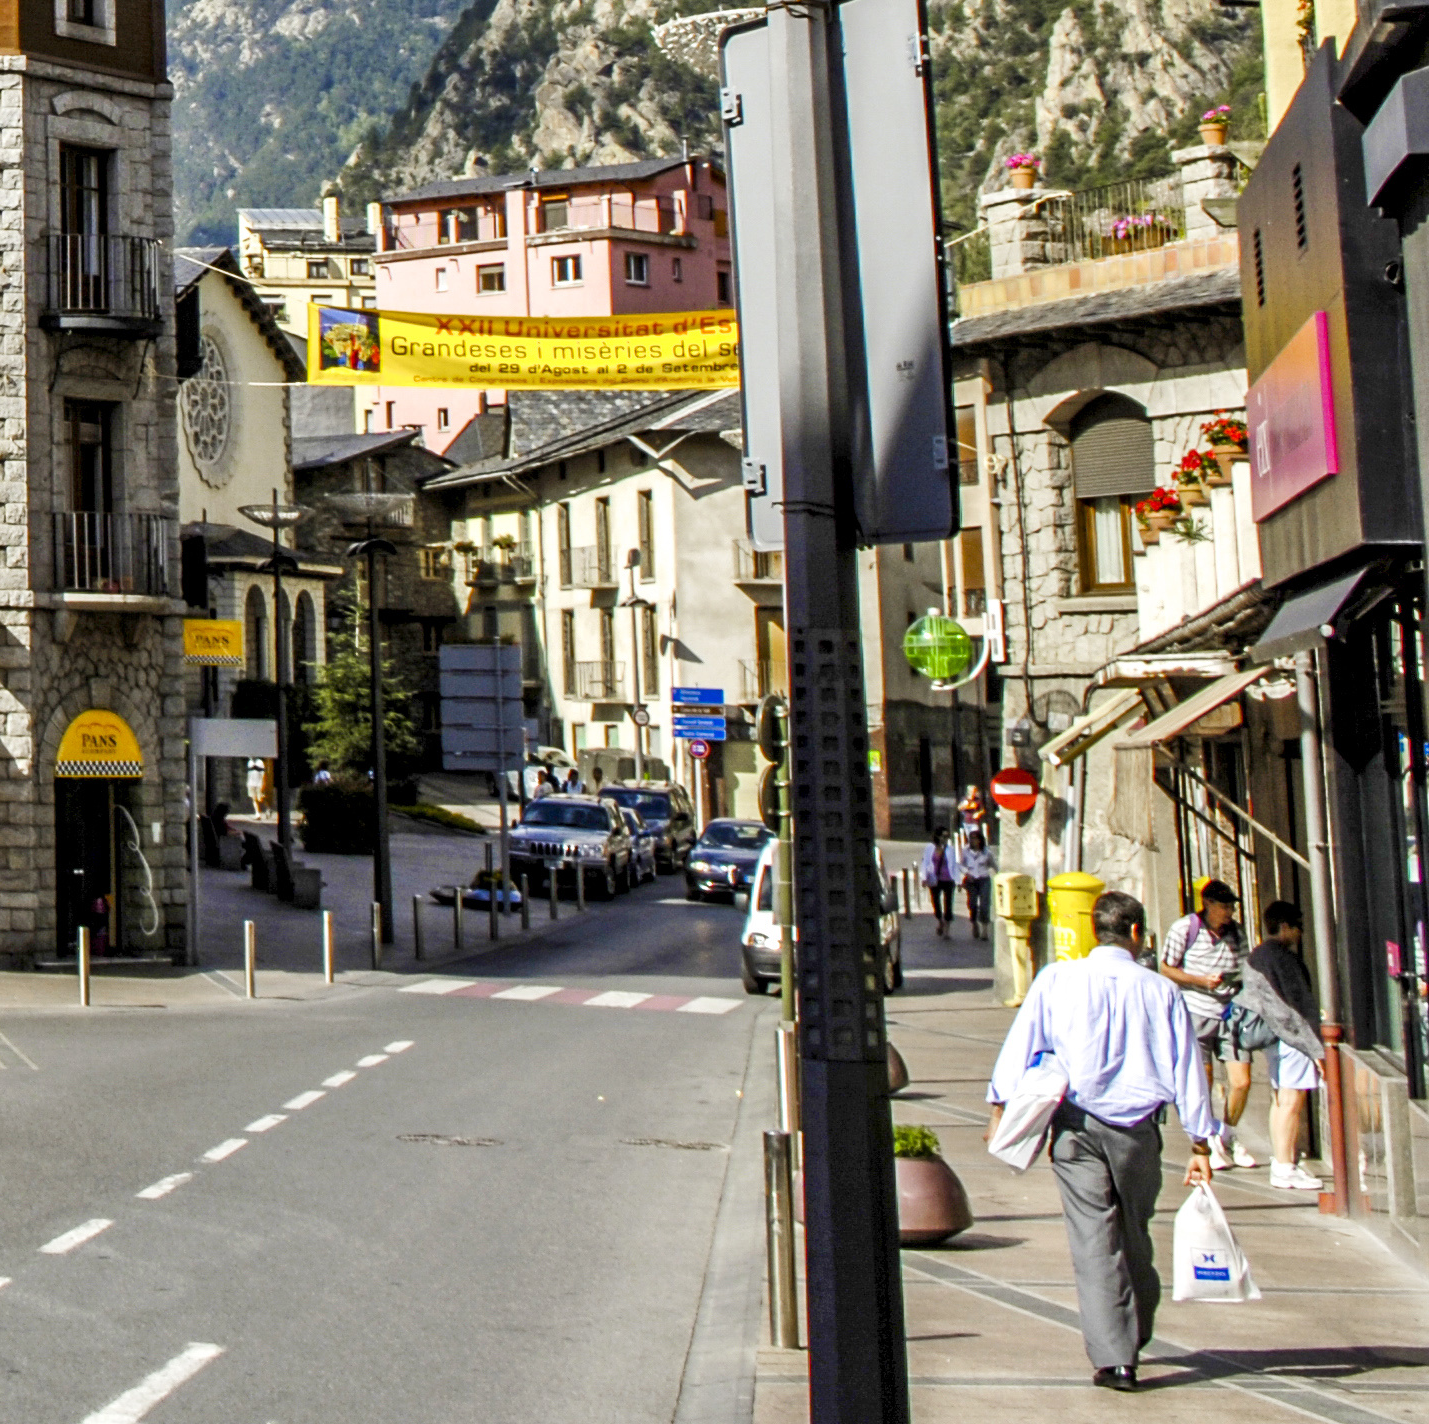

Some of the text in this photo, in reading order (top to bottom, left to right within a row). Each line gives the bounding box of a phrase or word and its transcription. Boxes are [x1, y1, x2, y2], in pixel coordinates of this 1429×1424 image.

[435, 317, 494, 337] XXII
[504, 320, 663, 339] Universitat
[390, 335, 527, 359] Grandeses
[537, 341, 543, 359] i
[553, 341, 662, 359] misèries
[672, 340, 708, 358] del
[469, 362, 739, 377] del 29 d'Agost al 2 de Setembre
[81, 733, 117, 747] PANS
